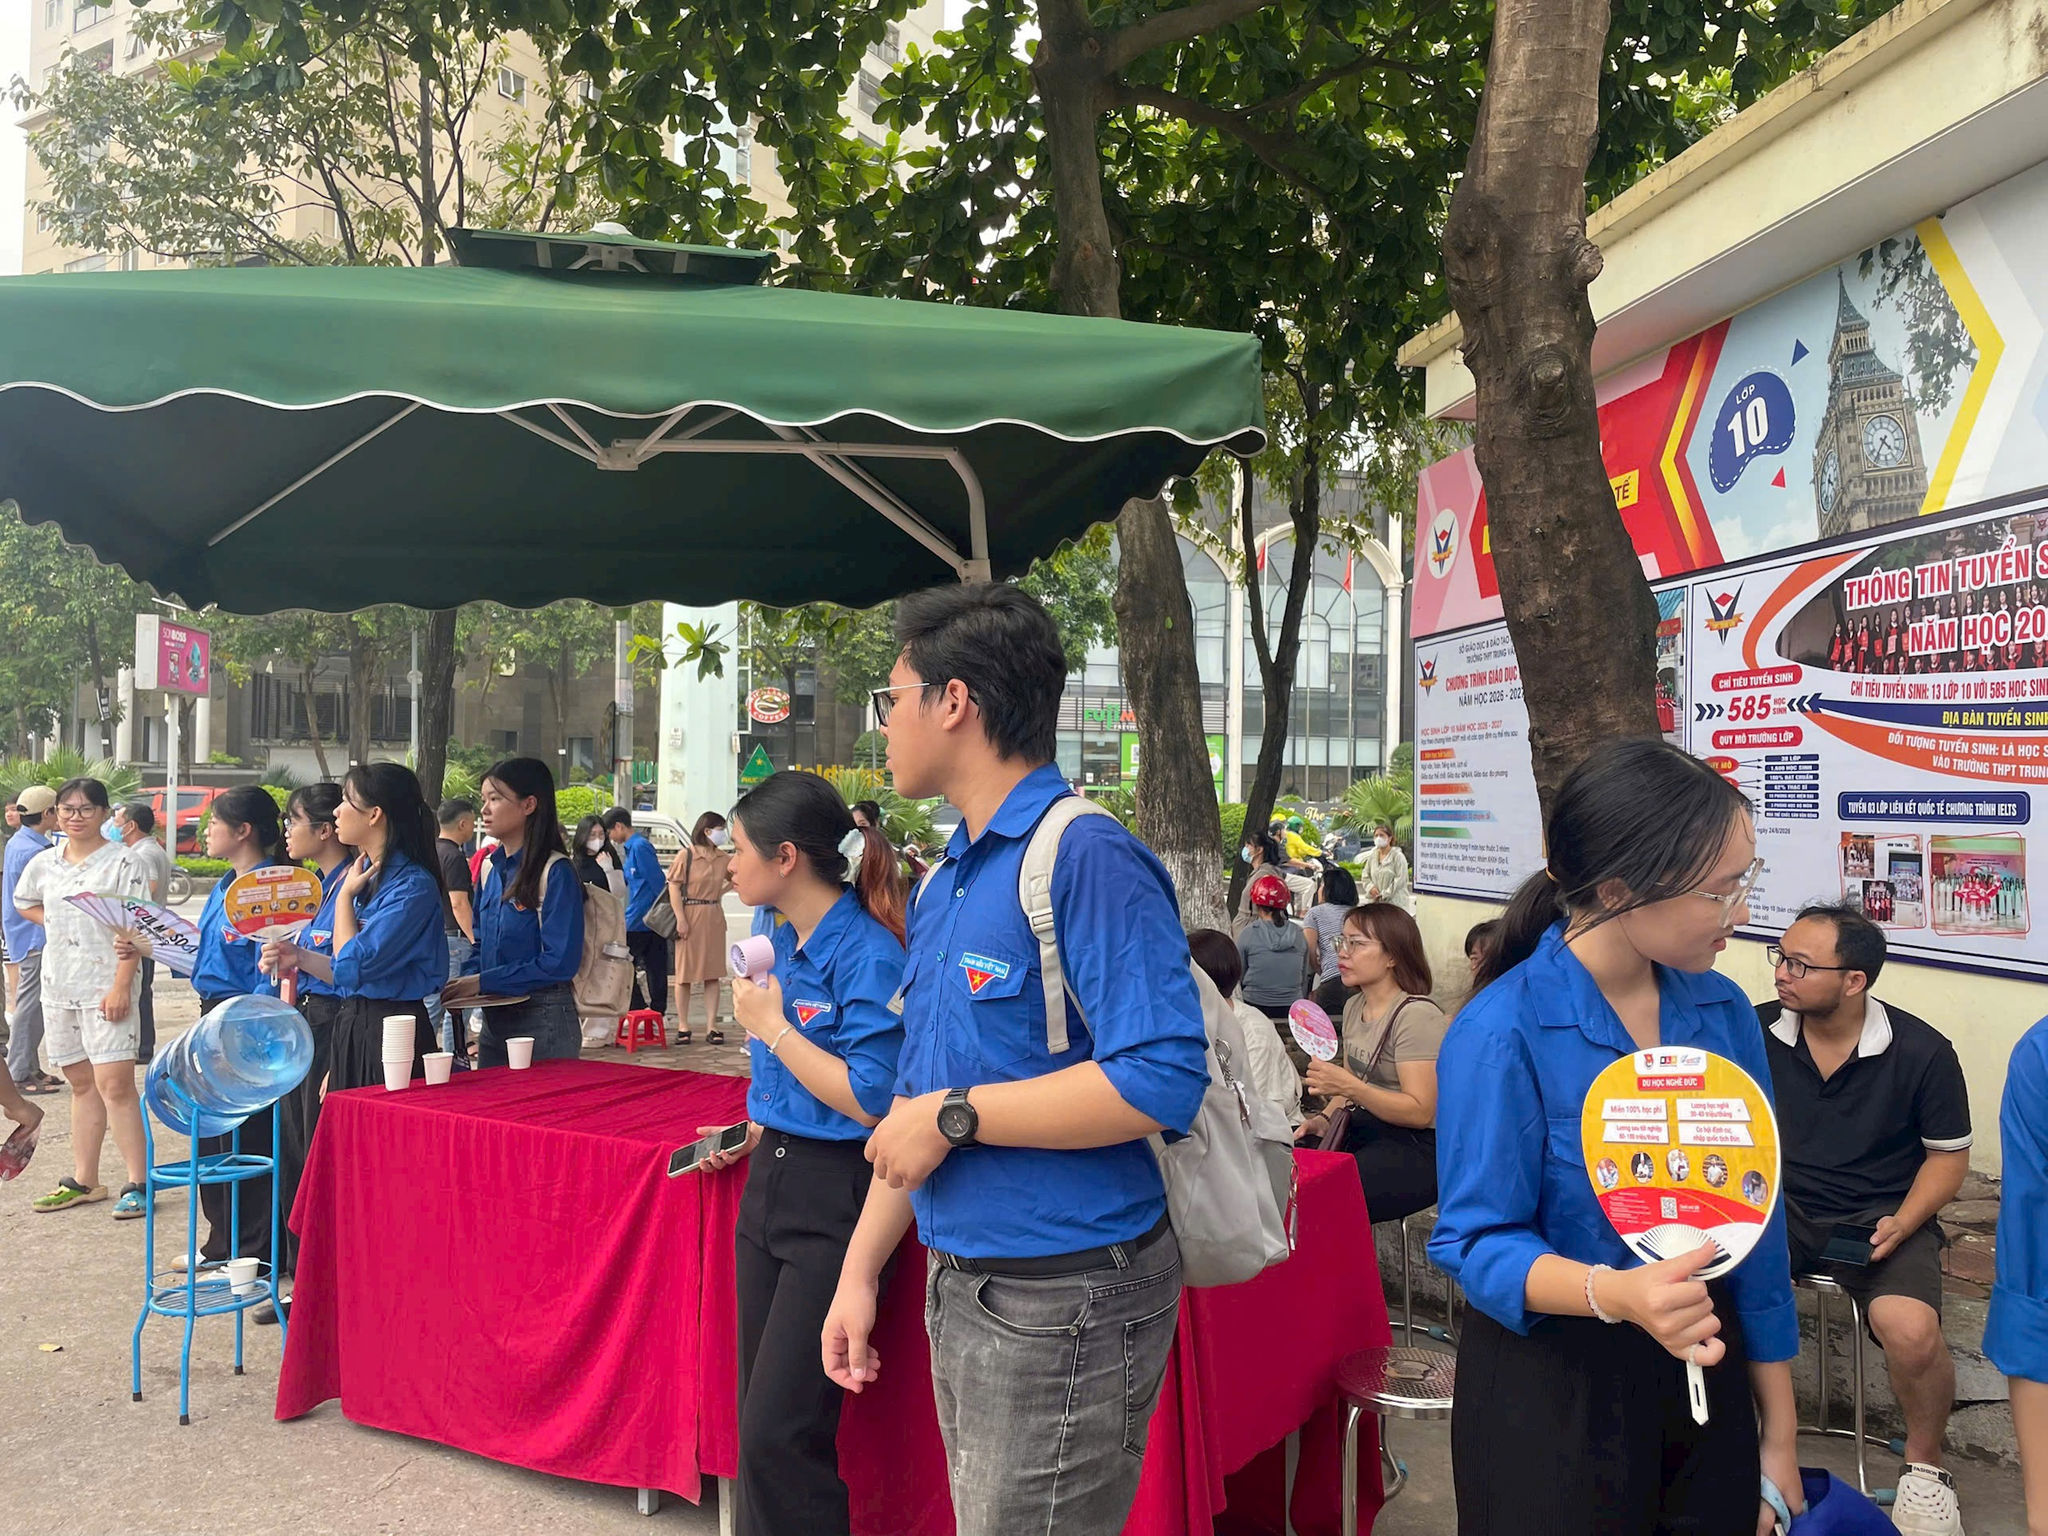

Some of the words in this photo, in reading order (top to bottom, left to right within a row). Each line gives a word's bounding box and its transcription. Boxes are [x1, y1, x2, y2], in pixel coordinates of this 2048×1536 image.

[1736, 384, 1755, 404] LỚP
[1728, 397, 1768, 458] 10
[1615, 476, 1631, 502] TẾ
[1846, 570, 1910, 608] THÔNG
[1918, 563, 1950, 595] TIN
[1958, 537, 2030, 589] TUYỂN
[1911, 618, 1956, 652] NĂM
[1964, 613, 2010, 654] HỌC
[2018, 608, 2046, 640] 20
[1446, 674, 1468, 692] CHƯƠNG
[1470, 668, 1487, 688] TRÌNH
[1488, 666, 1503, 685] GIÁO
[1505, 665, 1517, 684] DỤC
[1719, 677, 1731, 689] CHỈ
[1733, 676, 1748, 688] TIÊU
[1750, 672, 1773, 686] TUYỂN
[1775, 672, 1793, 684] SINH
[1850, 677, 1863, 696] CHỈ
[1865, 679, 1880, 698] TIÊU
[1882, 677, 1906, 698] TUYỂN
[1908, 683, 1929, 699] SINH:
[1932, 684, 1941, 700] 13
[1944, 680, 1958, 699] LỚP
[1962, 683, 1970, 699] 10
[1974, 680, 1988, 698] VỚI
[1990, 681, 2006, 698] 585
[2008, 680, 2027, 701] HỌC
[1459, 692, 1472, 708] NĂM
[1474, 693, 1488, 707] HỌC
[1489, 690, 1504, 703] 2026
[1728, 694, 1771, 722] 585
[1774, 698, 1786, 706] HỌC
[1942, 711, 1960, 727] ĐỊA
[1962, 709, 1984, 726] BÀN
[1987, 706, 2021, 726] TUYỂN
[1720, 735, 1732, 746] QUY
[1735, 733, 1746, 744] MÔ
[1748, 731, 1777, 744] TRƯỜNG
[1780, 730, 1794, 742] LỚP
[1888, 730, 1904, 744] ĐỐI
[1906, 735, 1935, 750] TƯỢNG
[1939, 737, 1968, 753] TUYỂN
[1971, 743, 1999, 756] SINH:
[2002, 742, 2015, 756] LÀ
[2018, 745, 2040, 759] HỌC
[1932, 755, 1950, 769] VÀO
[1953, 757, 1990, 774] TRƯỜNG
[1992, 764, 2016, 776] THPT
[1848, 798, 1866, 814] TUYỂN
[1868, 803, 1875, 814] 03
[1876, 800, 1888, 814] LỚP
[1889, 800, 1903, 815] LIÊN
[1904, 799, 1916, 815] KẾT
[1918, 799, 1935, 816] QUỐC
[1936, 799, 1945, 815] TẾ
[1946, 802, 1974, 816] CHƯƠNG
[1975, 800, 1996, 816] TRÌNH
[1998, 804, 2017, 817] IELTS
[1652, 1079, 1665, 1088] HỌC
[1666, 1076, 1683, 1086] NGHỀ
[1684, 1076, 1698, 1086] ĐỨC
